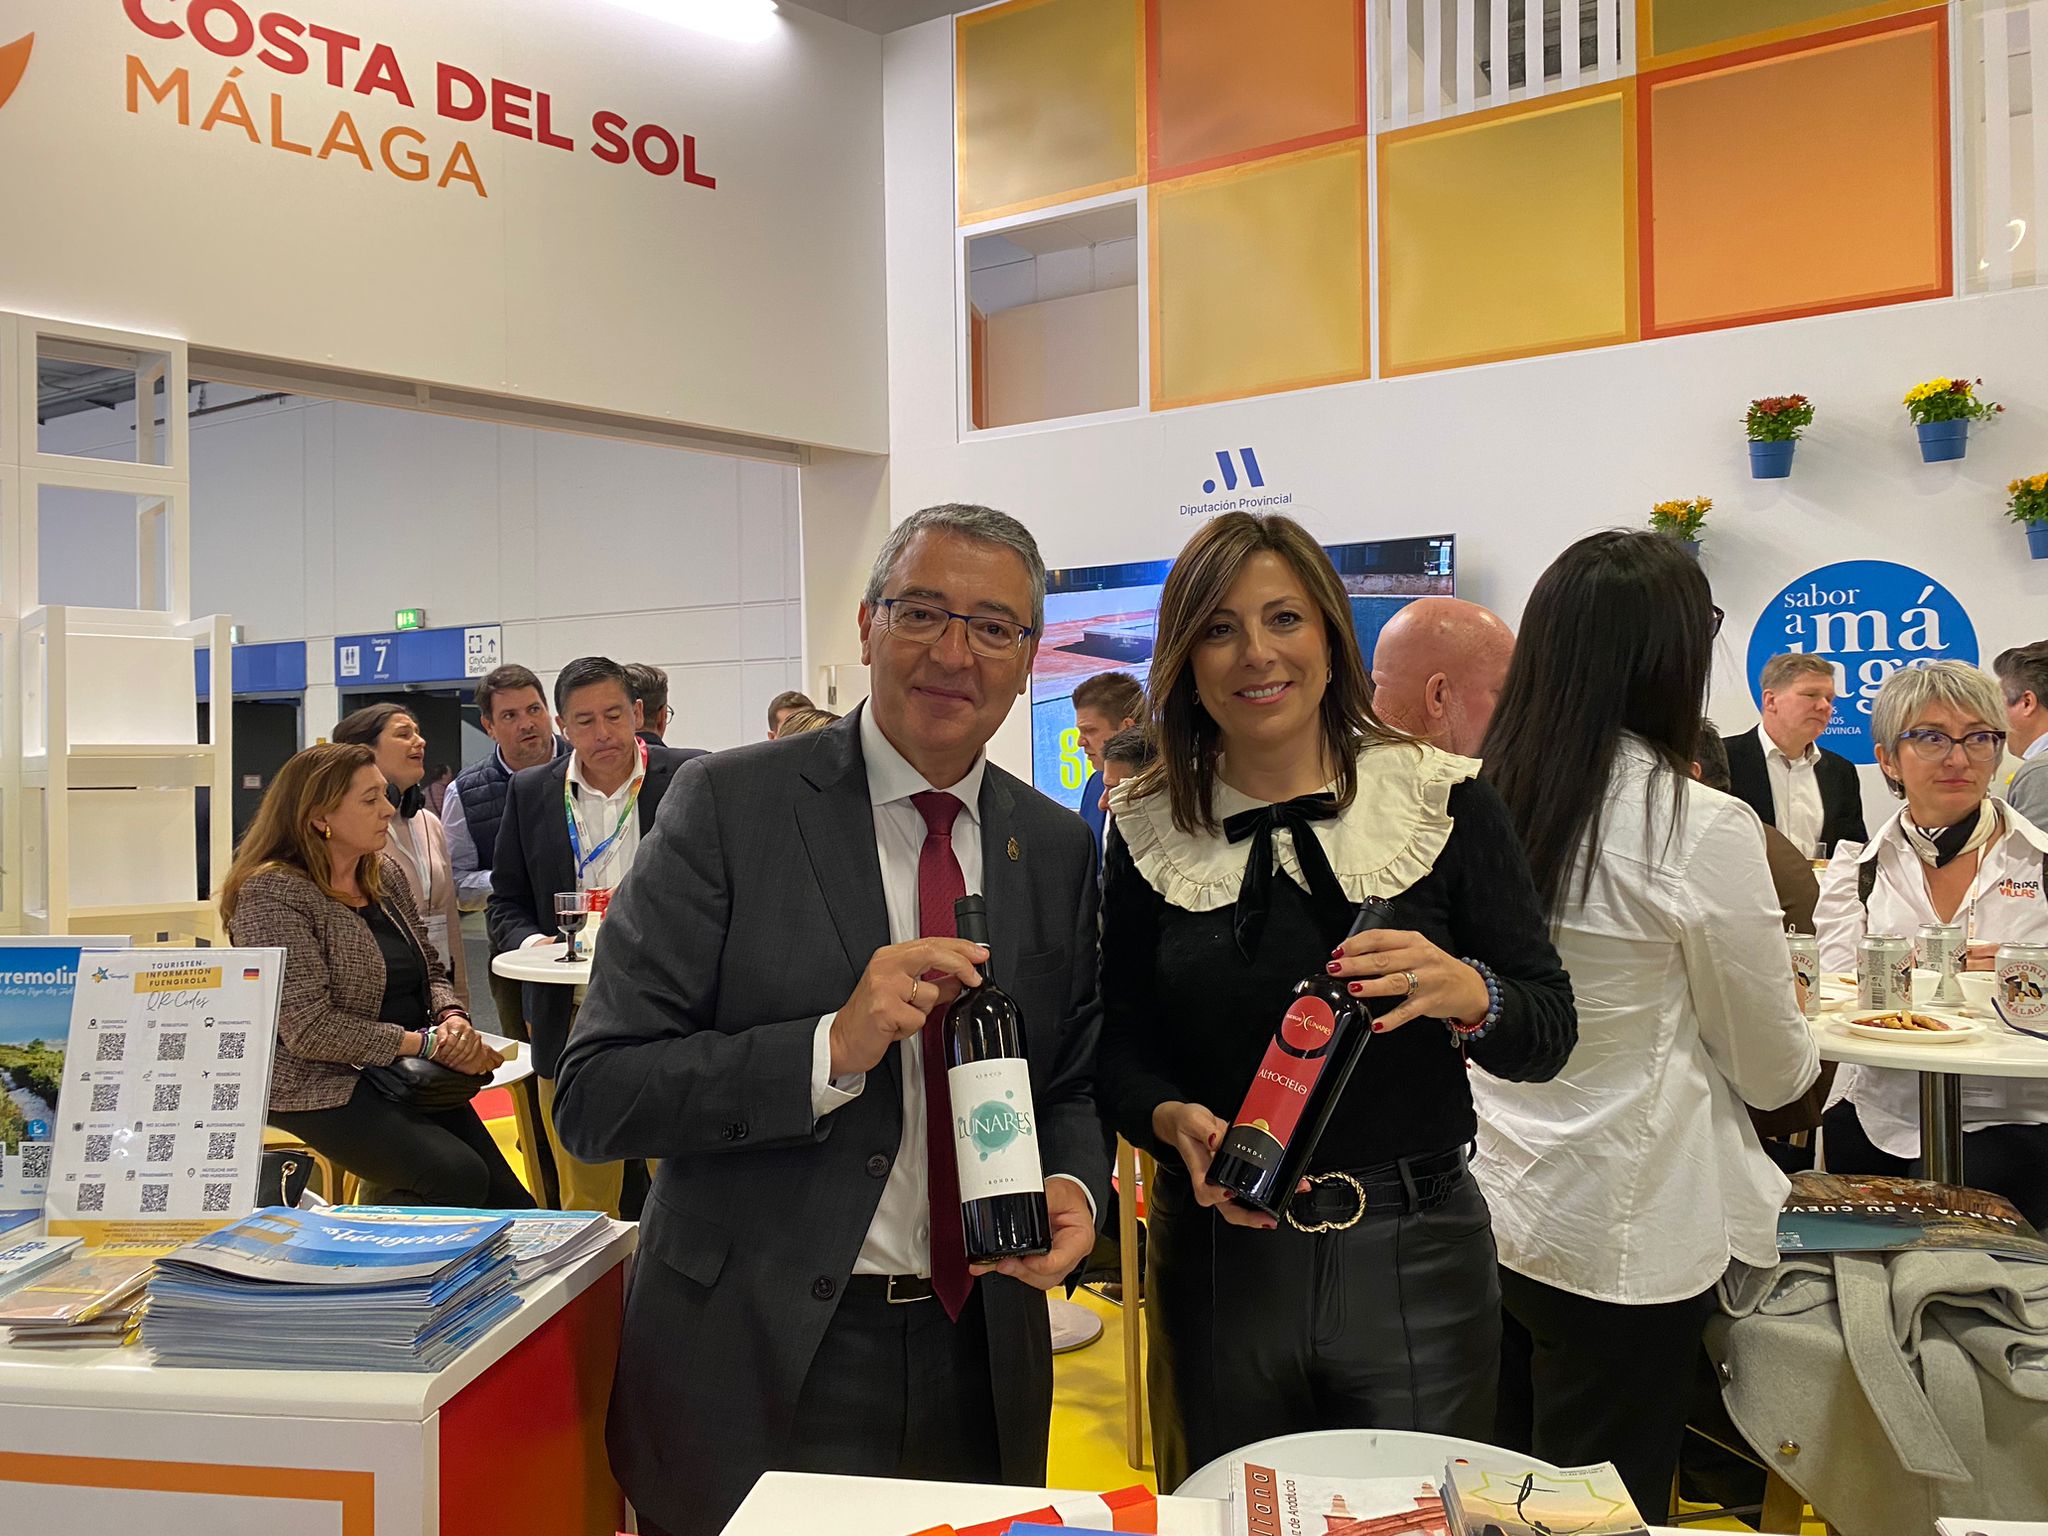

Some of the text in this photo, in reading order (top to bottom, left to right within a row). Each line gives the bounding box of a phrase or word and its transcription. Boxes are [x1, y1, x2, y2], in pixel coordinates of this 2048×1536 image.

[122, 0, 716, 189] COSTA DEL SOL
[126, 54, 488, 198] MÁLAGA
[1180, 500, 1236, 516] Diputación
[1239, 493, 1292, 508] Provincial
[1784, 583, 1860, 608] sabor
[1785, 585, 1950, 654] a má
[375, 646, 387, 672] 7
[469, 656, 497, 666] CityCube
[469, 665, 487, 674] Berlin
[1822, 726, 1862, 735] OVINCIA
[2000, 888, 2036, 899] VILLAS
[146, 968, 211, 979] INFORMATION
[152, 960, 206, 969] TOURISTEN-
[2001, 964, 2047, 981] VICTORIA
[149, 977, 207, 987] FUENGIROLA
[147, 990, 209, 1011] QR Codes
[1258, 1068, 1308, 1095] ALTOCIELO
[958, 1112, 1032, 1139] LUNARES
[1867, 1205, 1897, 1213] SU
